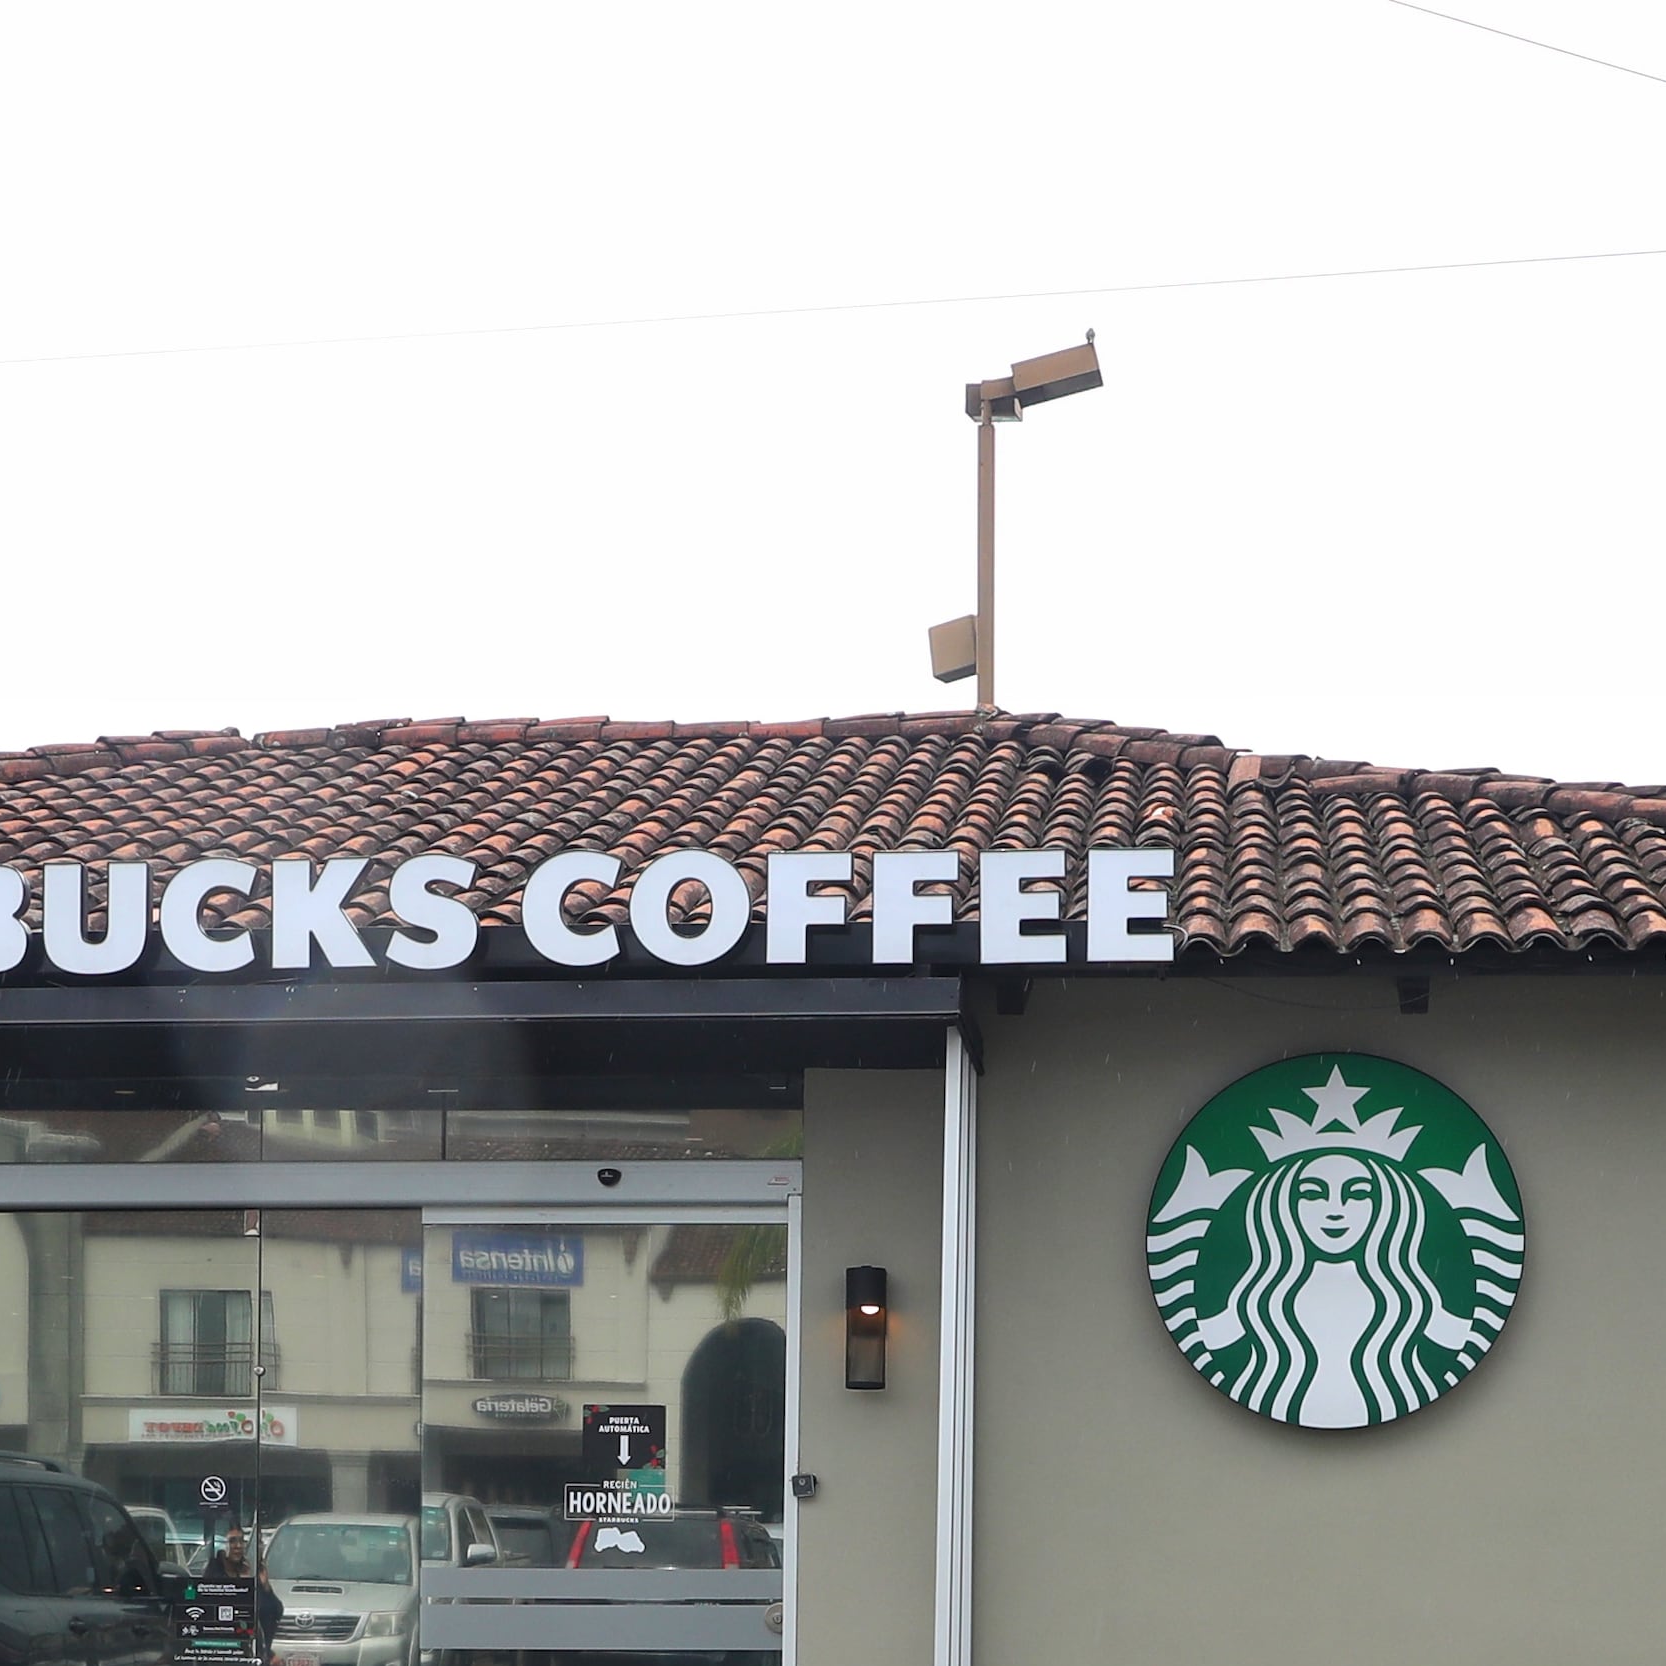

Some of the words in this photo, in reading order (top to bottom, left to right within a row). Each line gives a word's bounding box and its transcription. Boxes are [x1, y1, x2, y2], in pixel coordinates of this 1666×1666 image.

[522, 849, 1175, 965] COFFEE
[598, 1424, 650, 1433] AUTOMÁTICA
[603, 1479, 637, 1489] RECIÉN
[569, 1492, 671, 1514] HORNEADO
